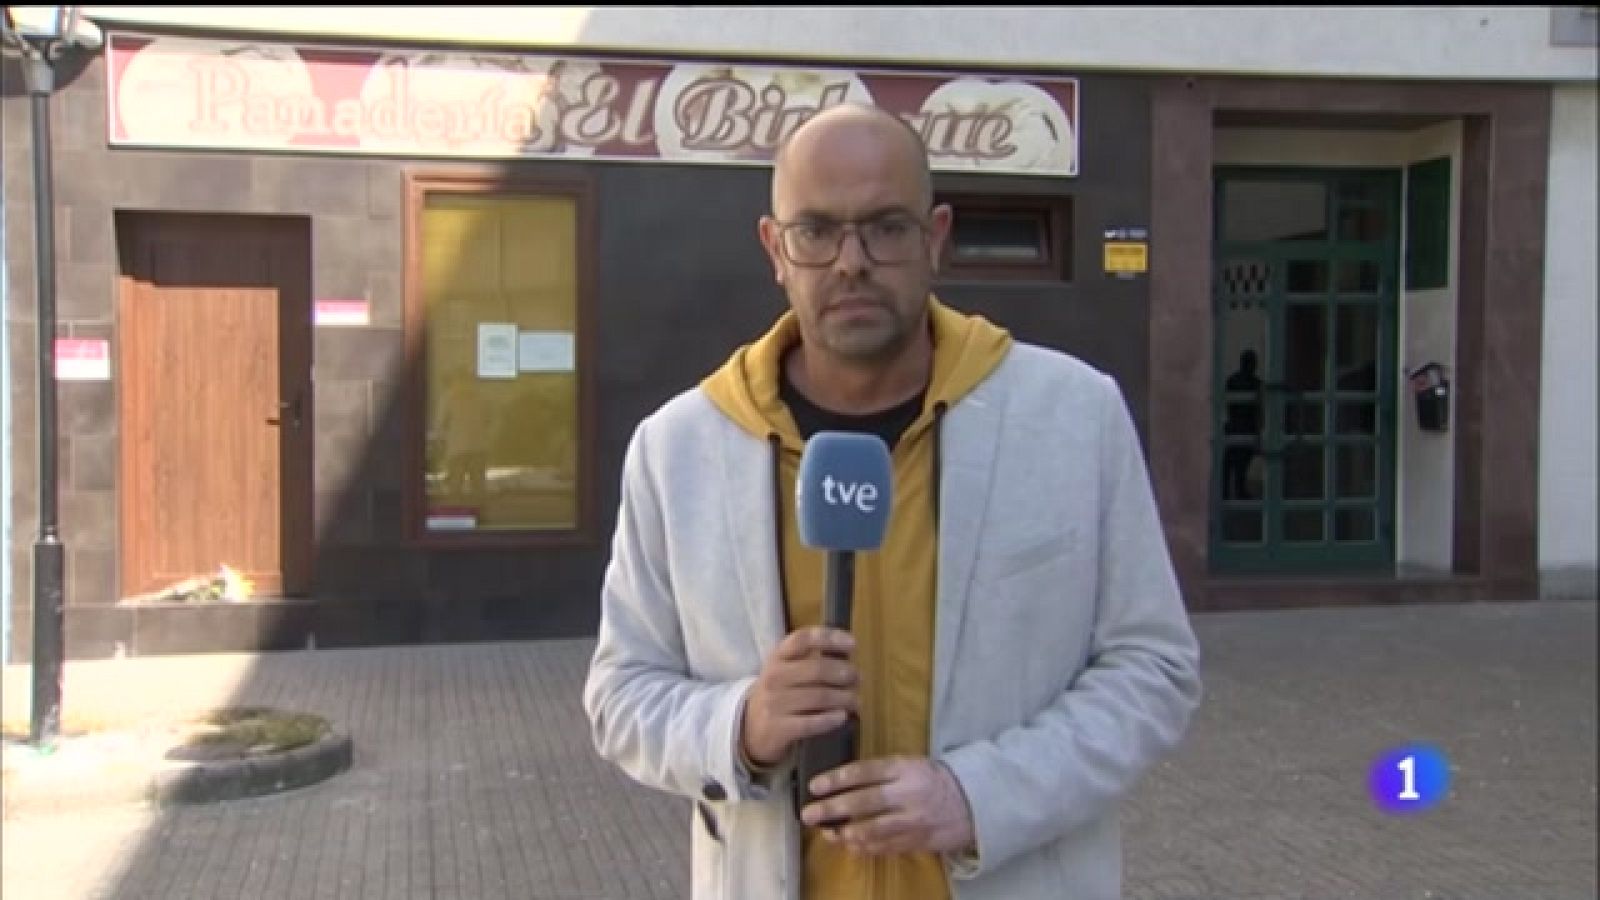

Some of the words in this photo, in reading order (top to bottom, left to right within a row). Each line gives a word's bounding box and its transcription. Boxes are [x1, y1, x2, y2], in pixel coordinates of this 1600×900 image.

[187, 57, 541, 144] Panadería
[560, 84, 658, 146] El
[822, 475, 877, 513] tve
